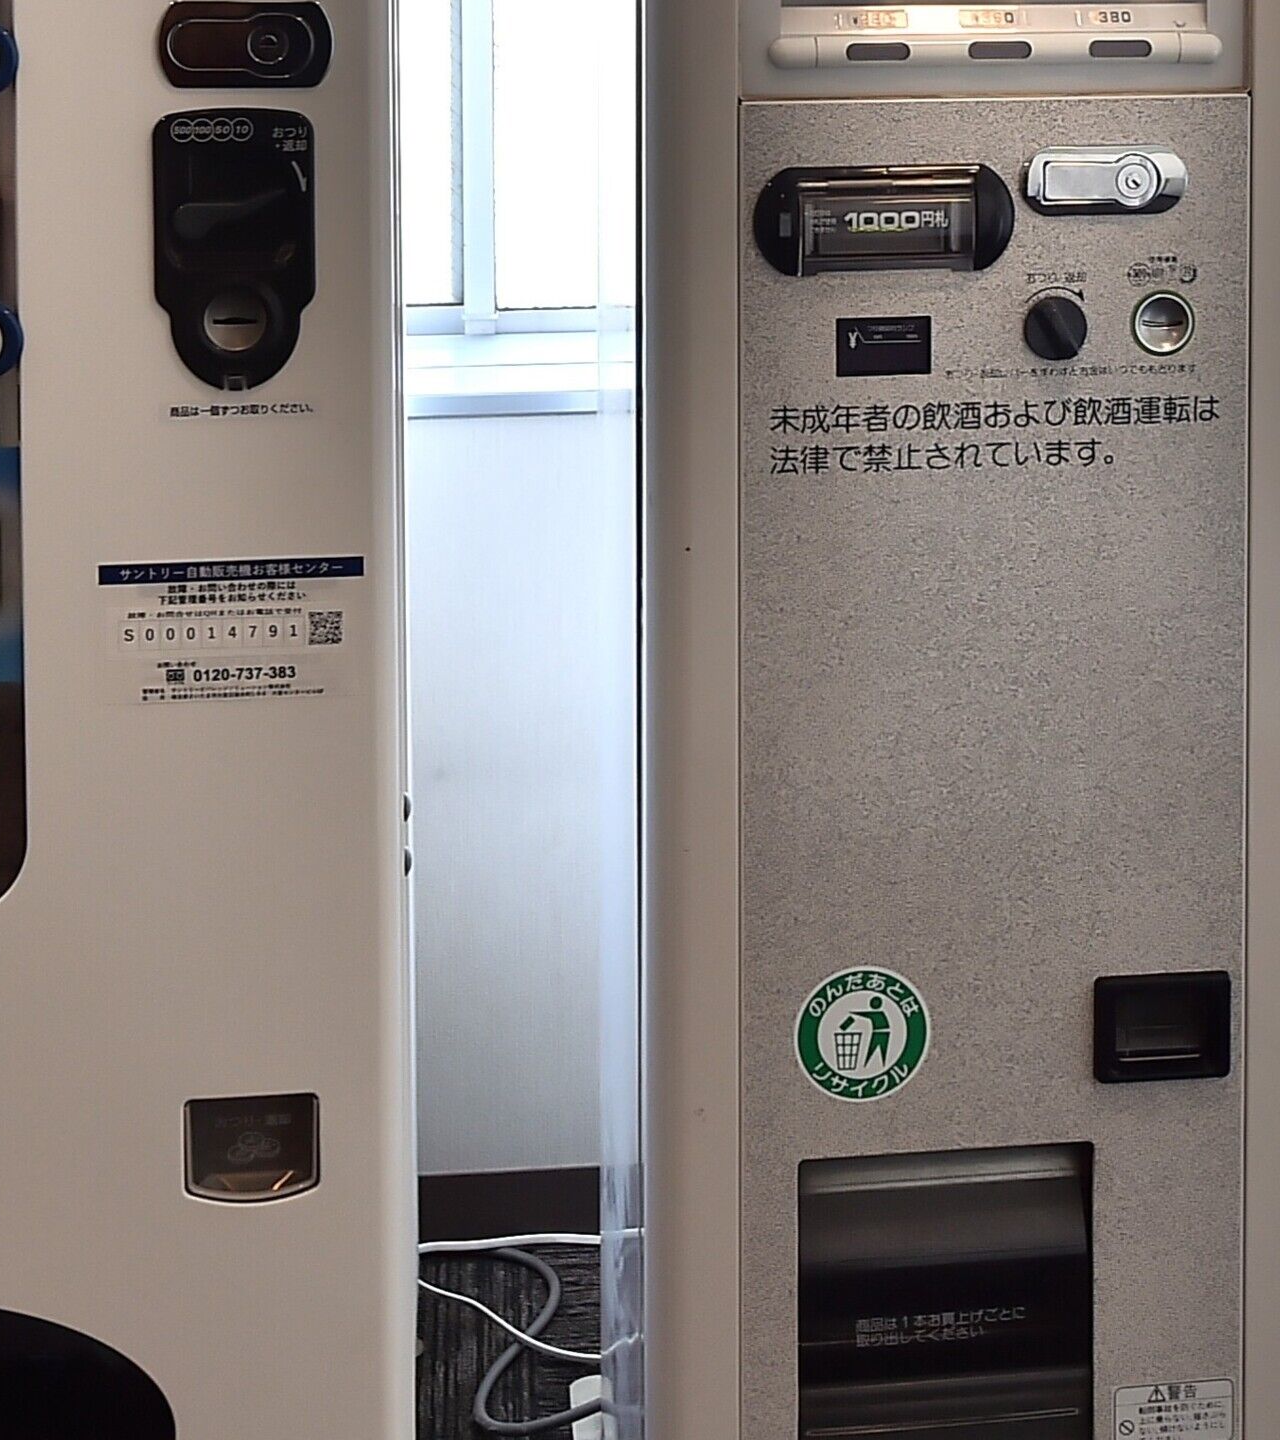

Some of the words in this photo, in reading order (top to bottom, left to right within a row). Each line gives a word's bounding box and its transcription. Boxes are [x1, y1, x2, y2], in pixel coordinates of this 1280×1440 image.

[215, 125, 230, 135] 50
[235, 125, 249, 134] 10
[272, 126, 308, 138] おつり
[844, 209, 950, 231] 1000円札
[769, 395, 1220, 435] 未成年者の飲酒および飲酒運転は
[770, 437, 1115, 475] 法律で禁止されています。
[120, 562, 345, 580] サントリー自動販売機お客様センター
[193, 665, 297, 682] 0120-737-383
[808, 972, 920, 1018] のんだあとは
[811, 1061, 909, 1098] リサイクル
[1167, 1384, 1198, 1401] 警告
